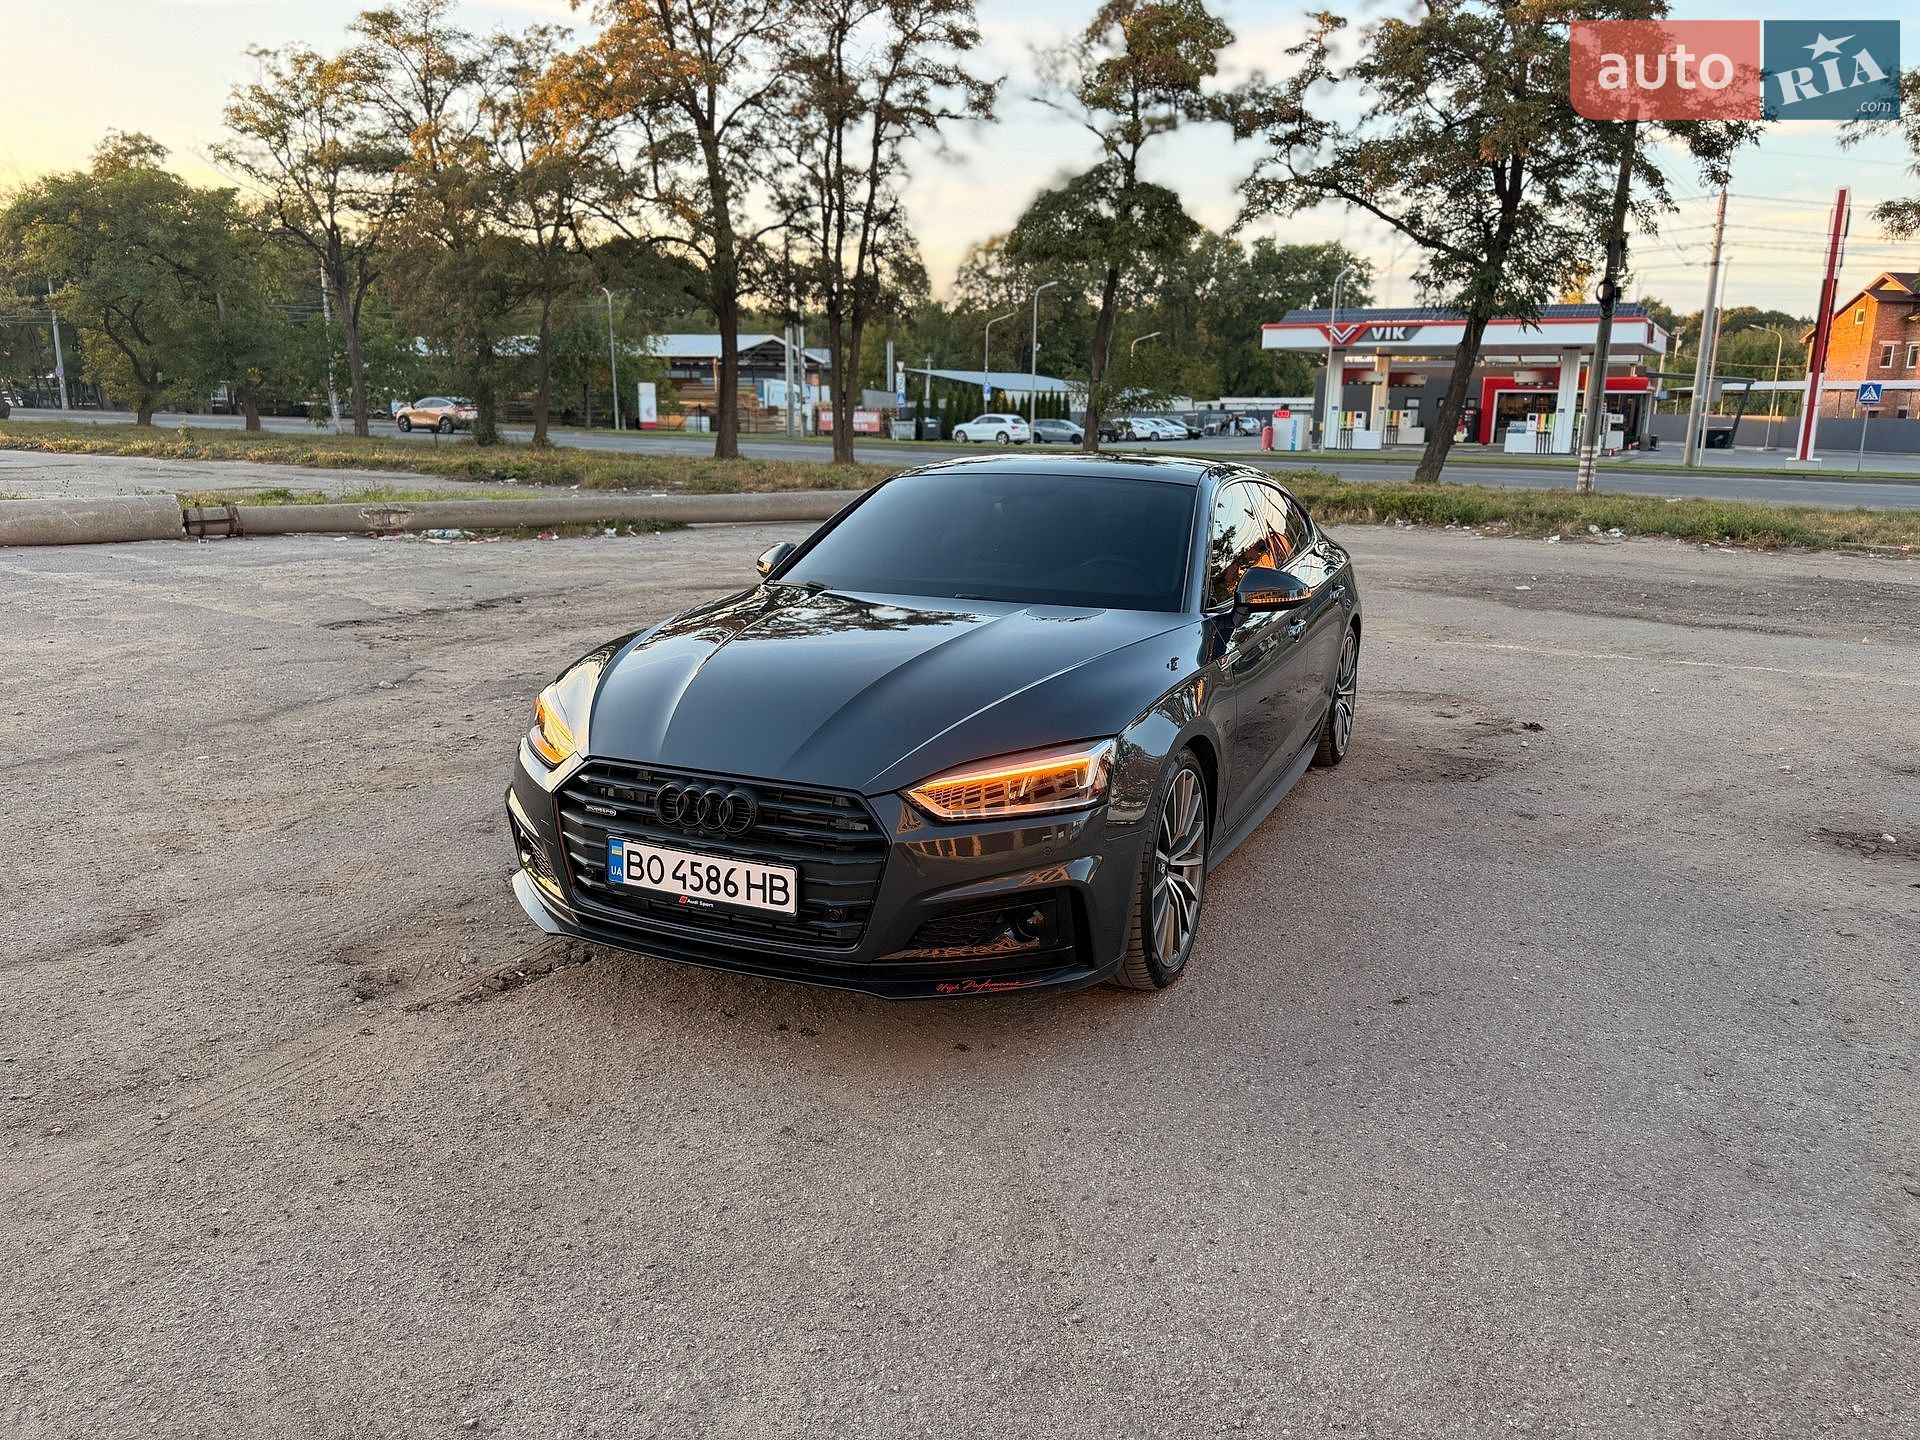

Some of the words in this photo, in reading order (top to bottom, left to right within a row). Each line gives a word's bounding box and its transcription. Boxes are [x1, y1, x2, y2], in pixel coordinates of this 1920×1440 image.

[1371, 326, 1408, 340] VIK
[611, 865, 623, 876] UA
[626, 850, 665, 885] BO
[671, 859, 739, 898] 4586
[745, 870, 790, 906] HB
